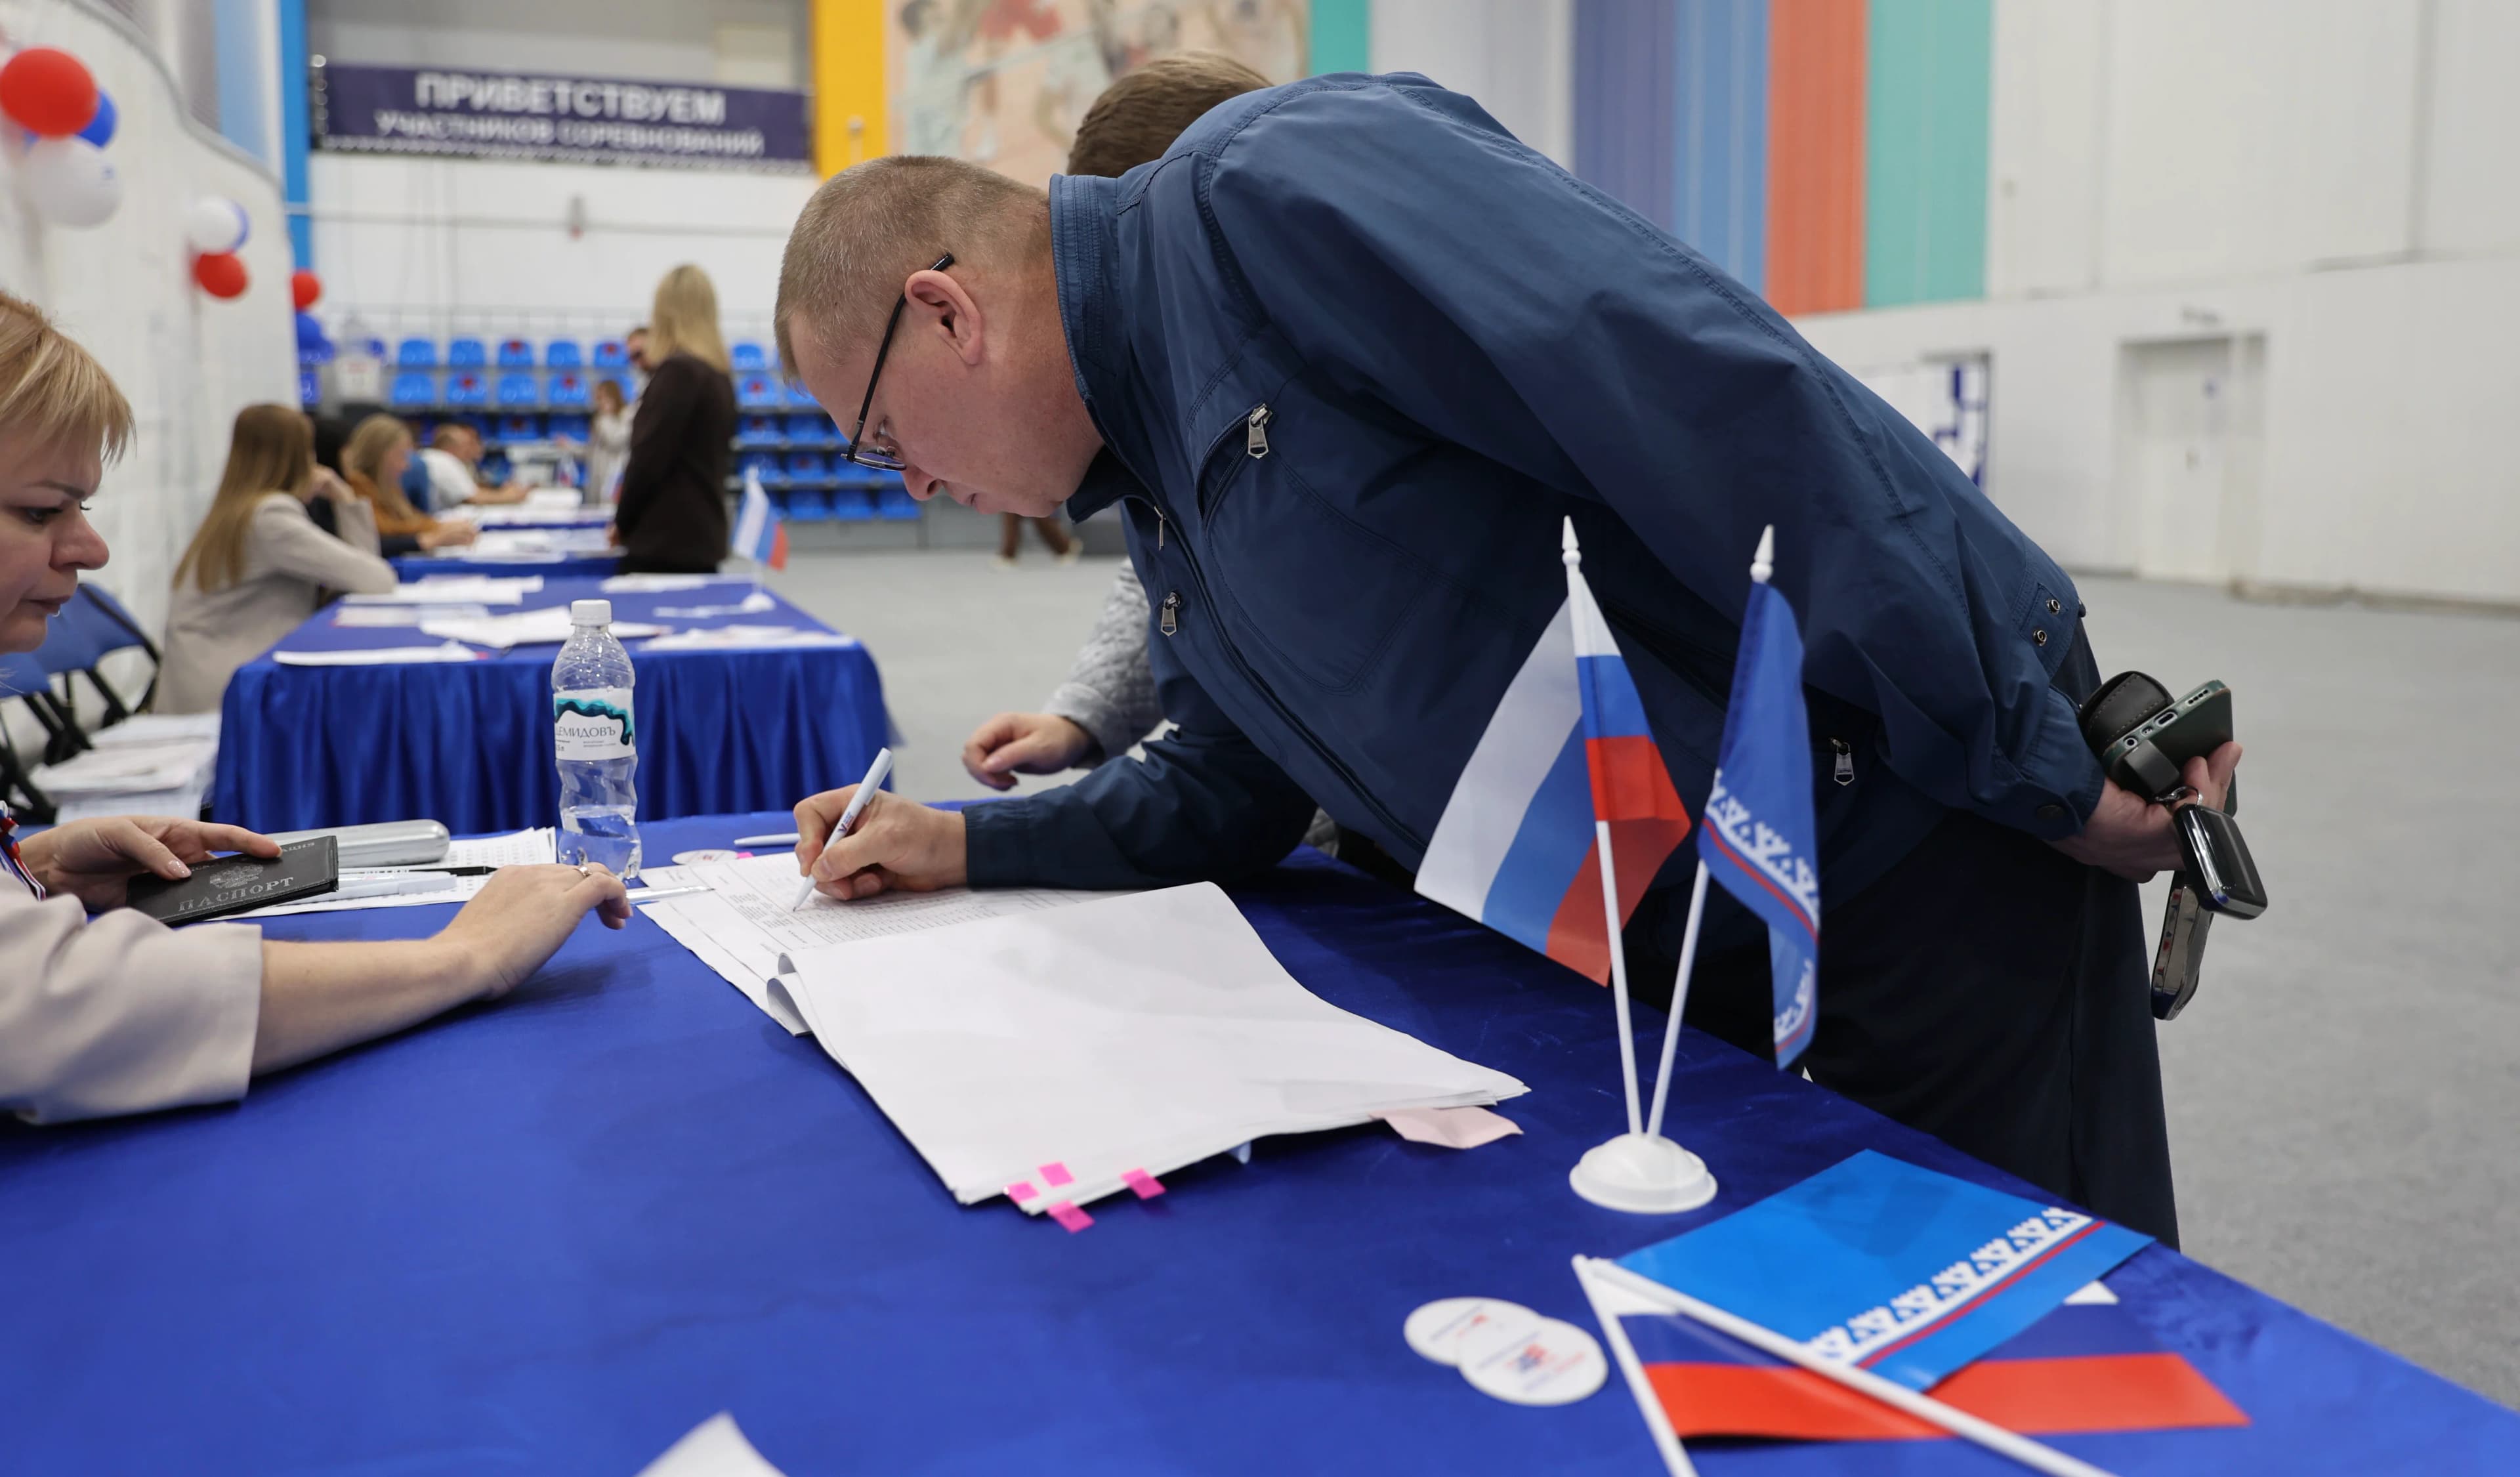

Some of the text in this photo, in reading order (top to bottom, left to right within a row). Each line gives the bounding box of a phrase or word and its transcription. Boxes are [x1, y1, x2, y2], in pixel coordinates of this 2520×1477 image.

[415, 72, 727, 126] ПРИВЕТСТВУЕМ
[373, 110, 765, 157] УЧАСТНИКОВ СОРЕВНОВАНИЙ
[178, 877, 294, 912] ПАСПОРТ
